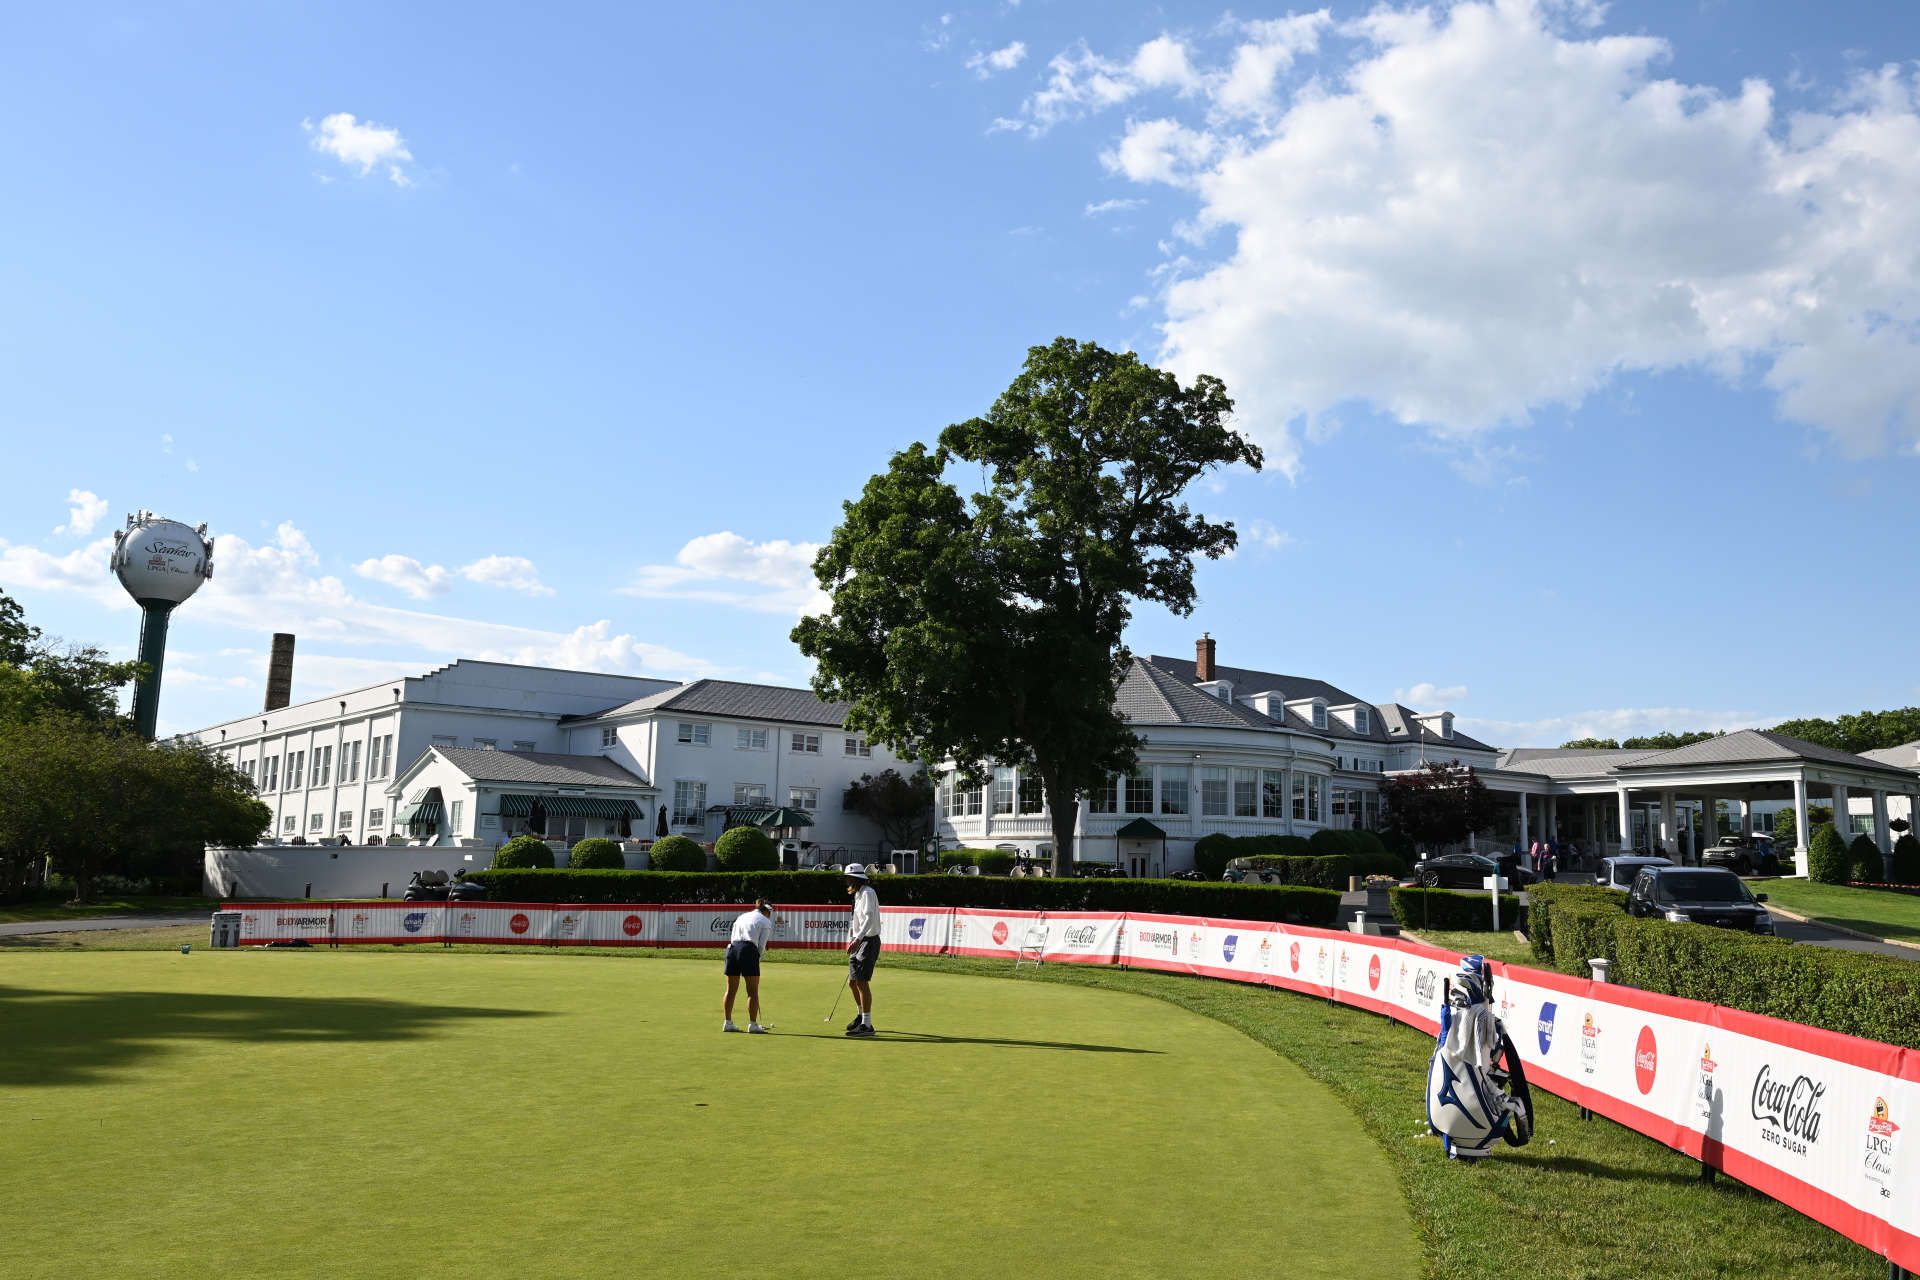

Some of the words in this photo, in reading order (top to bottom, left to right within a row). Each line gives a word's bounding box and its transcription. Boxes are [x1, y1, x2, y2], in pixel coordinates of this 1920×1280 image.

[276, 917, 327, 926] BODYARMOR
[804, 920, 849, 929] BODYARMOR
[1139, 931, 1172, 944] BODYARMOR
[1752, 1063, 1826, 1143] Coca-Cola
[1761, 1128, 1781, 1145] ZERO
[1782, 1137, 1807, 1157] SUGAR
